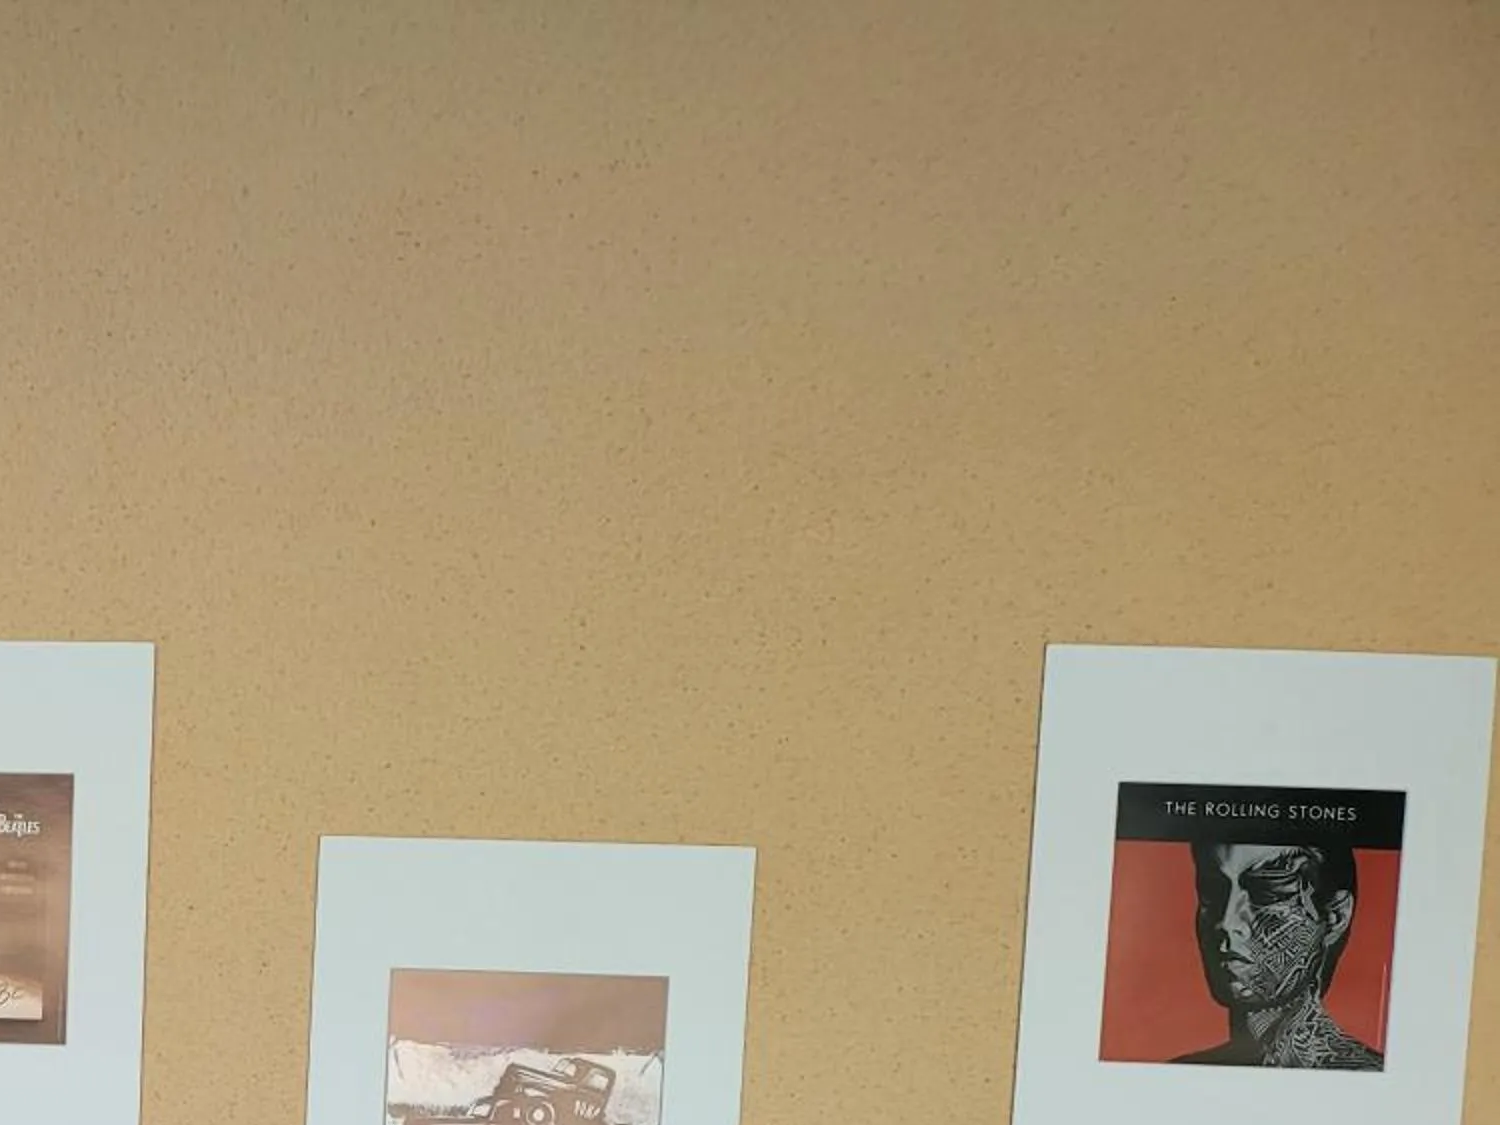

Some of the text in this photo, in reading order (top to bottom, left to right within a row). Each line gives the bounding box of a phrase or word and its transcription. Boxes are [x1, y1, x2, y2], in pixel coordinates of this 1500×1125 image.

[1166, 802, 1357, 821] THE ROLLING STONES
